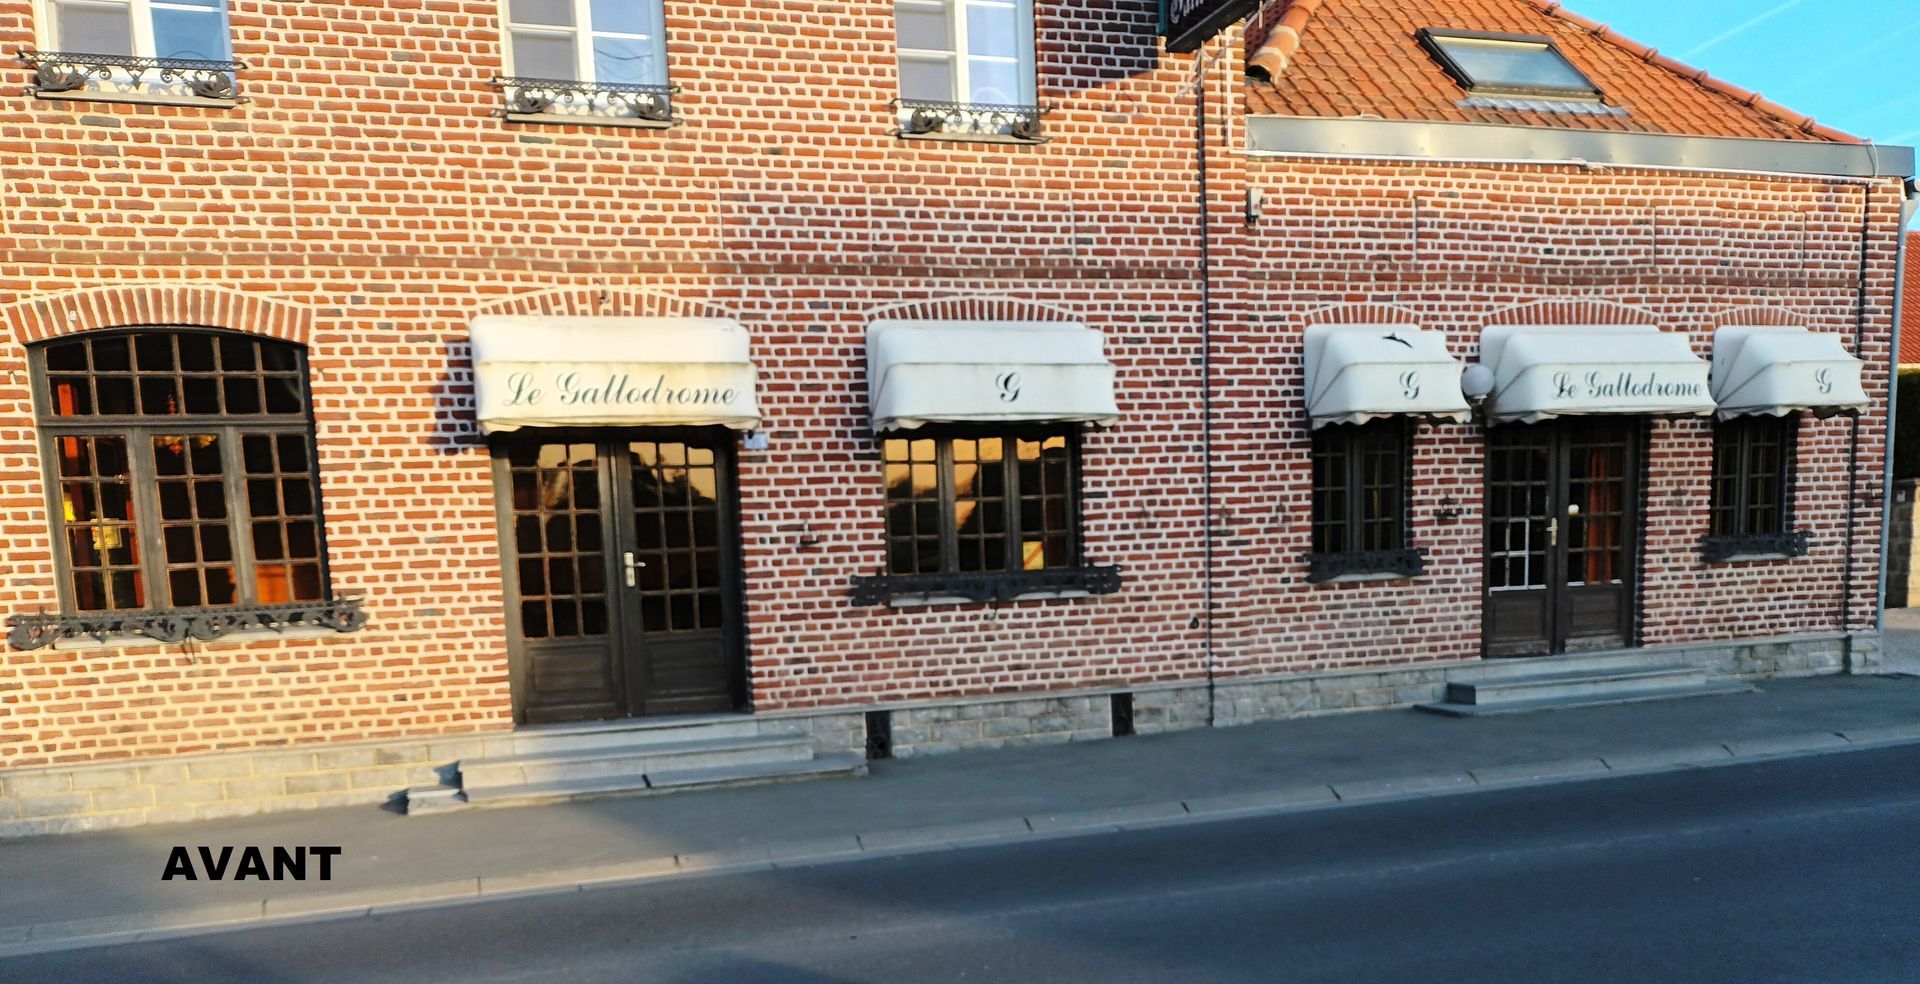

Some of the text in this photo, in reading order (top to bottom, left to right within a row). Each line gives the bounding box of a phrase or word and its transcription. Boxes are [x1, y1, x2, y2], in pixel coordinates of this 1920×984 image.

[502, 371, 738, 406] Le Gallodrome
[995, 371, 1021, 403] G
[1399, 371, 1420, 400] G
[1553, 370, 1701, 399] Le Gallodrome
[1815, 368, 1832, 393] G
